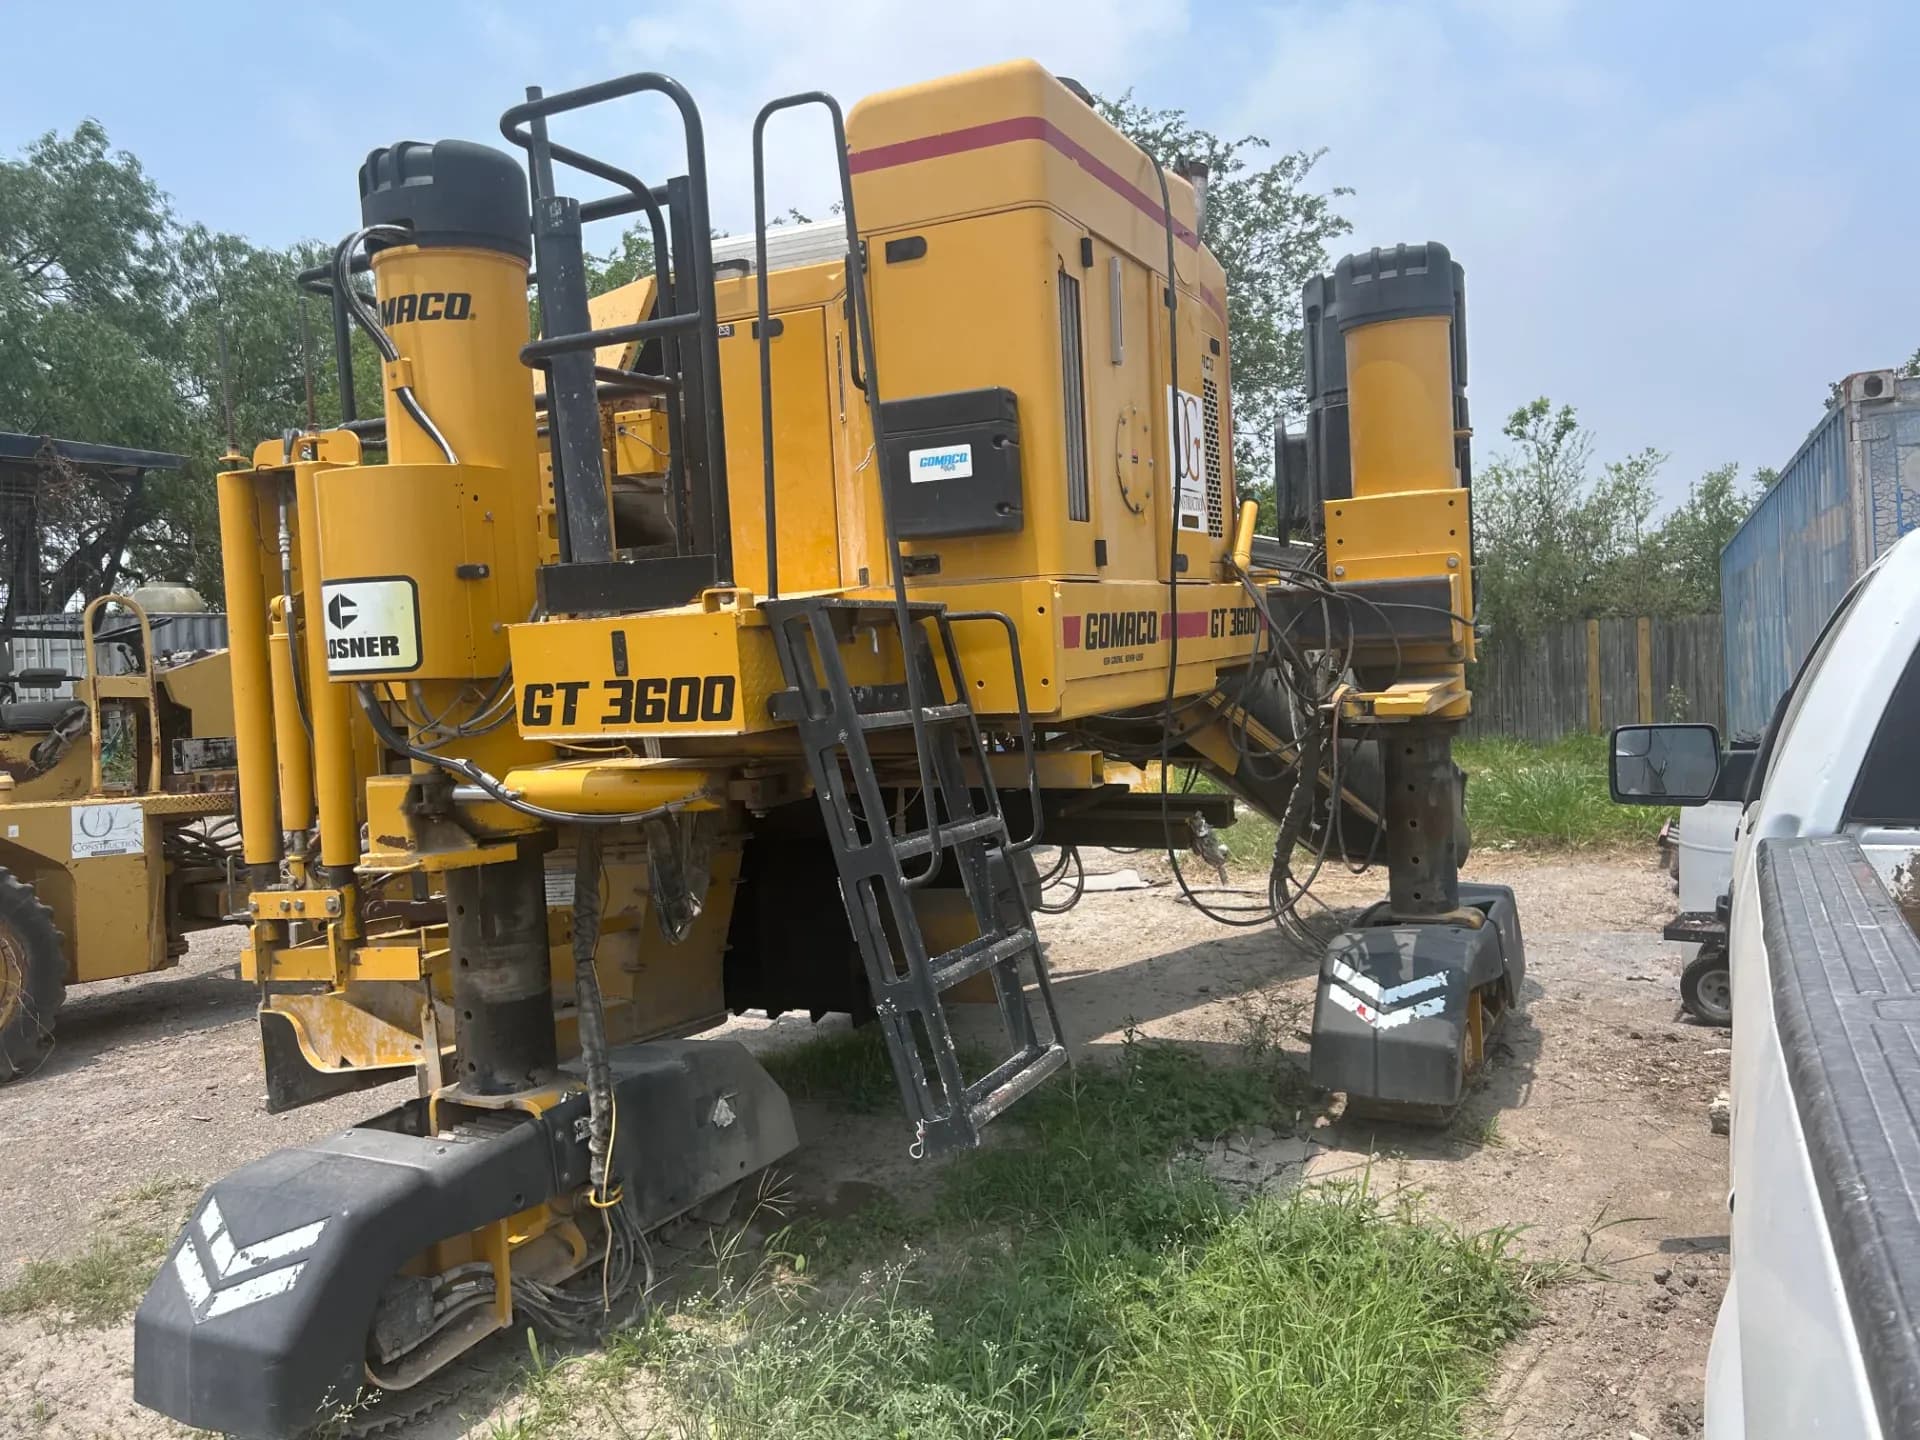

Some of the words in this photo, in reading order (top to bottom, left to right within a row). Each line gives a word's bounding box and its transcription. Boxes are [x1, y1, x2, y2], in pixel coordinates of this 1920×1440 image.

[380, 292, 472, 327] MACO
[920, 452, 968, 468] GOMACO
[1085, 610, 1159, 650] GOMACO
[1211, 608, 1228, 638] GT
[1229, 607, 1257, 636] 3600
[327, 636, 400, 659] OSNER
[522, 681, 590, 726] GT
[601, 675, 735, 724] 3600
